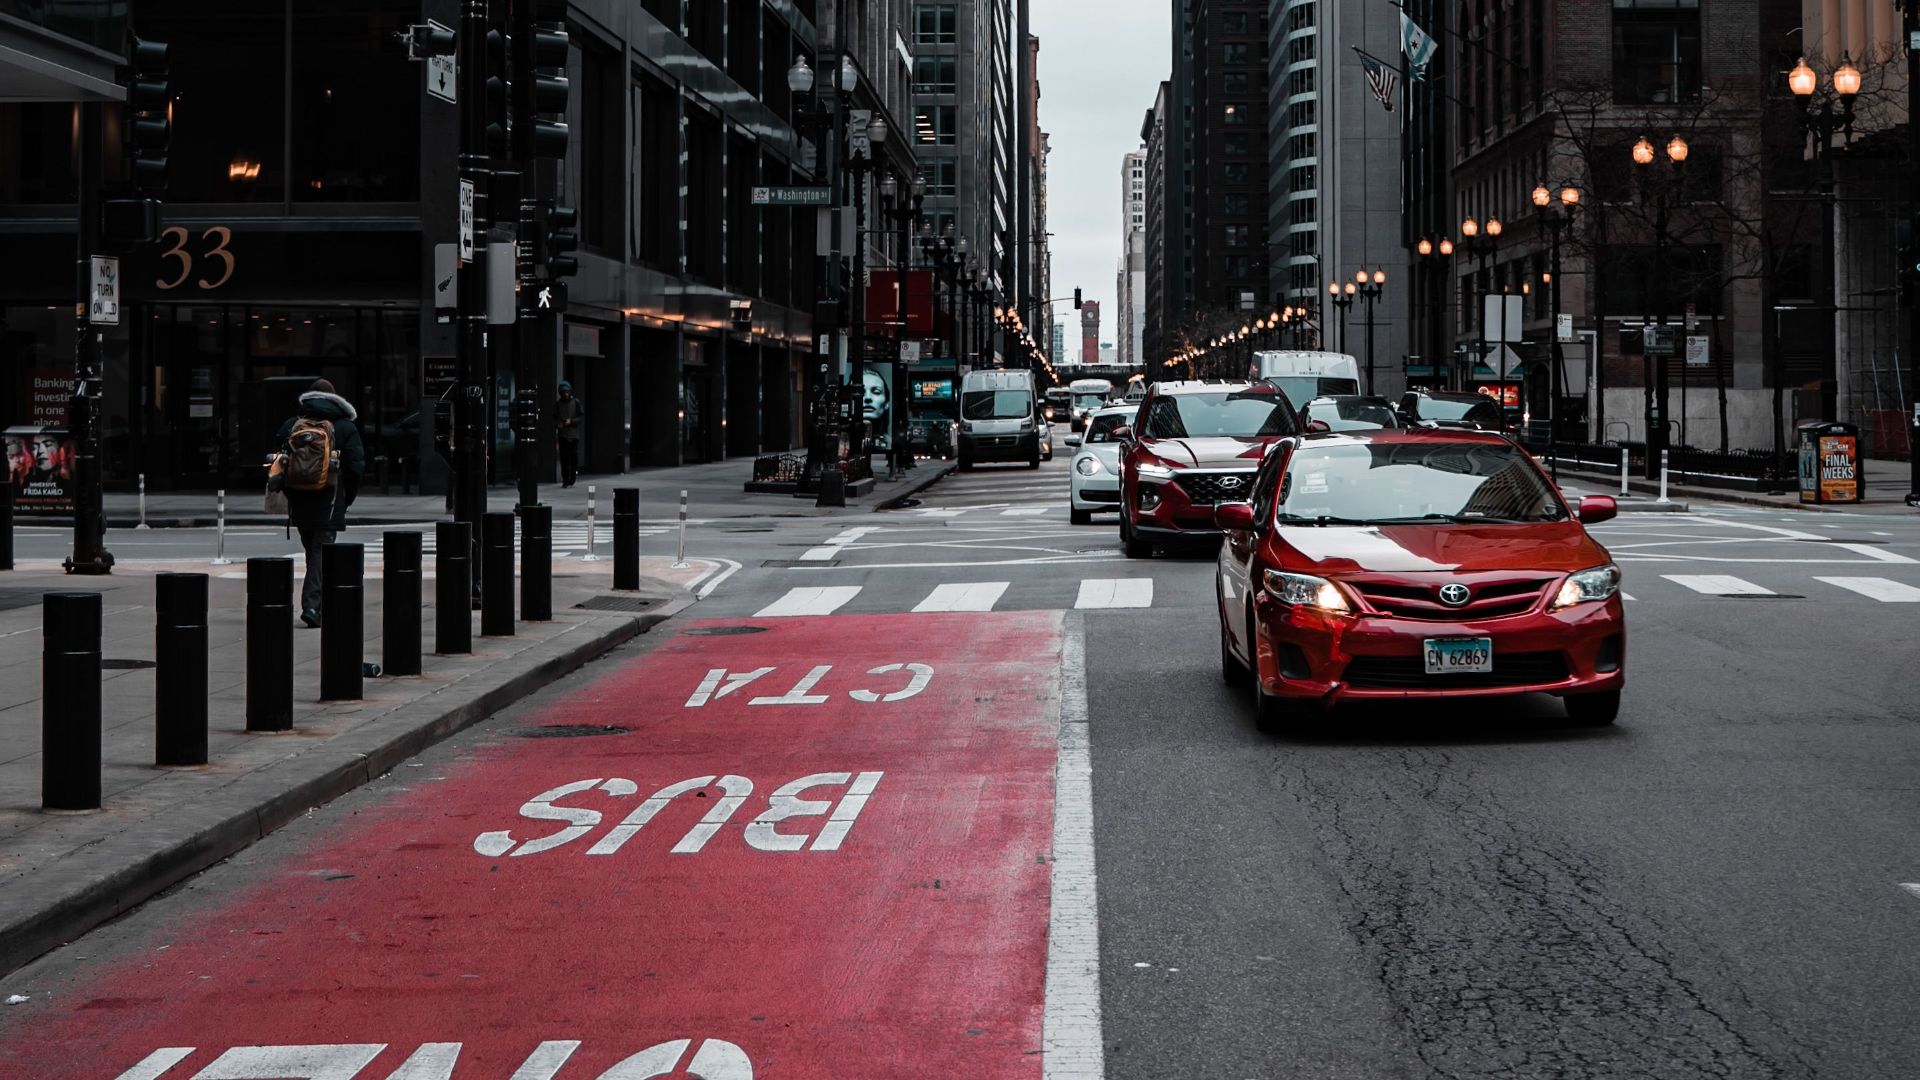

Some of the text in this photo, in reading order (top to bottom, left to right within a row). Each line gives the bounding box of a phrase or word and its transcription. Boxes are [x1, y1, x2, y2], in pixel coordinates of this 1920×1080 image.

[462, 186, 472, 207] ONE
[776, 189, 820, 204] Washington
[462, 209, 472, 228] WAY
[156, 226, 235, 289] 33
[100, 265, 111, 278] NO
[97, 283, 114, 297] TURN
[93, 302, 103, 315] ON
[34, 377, 75, 391] Banking
[34, 406, 44, 415] in
[1825, 454, 1851, 467] FINAL
[1823, 467, 1854, 479] WEEKS
[23, 488, 64, 496] FRIDA KAHLO
[1428, 648, 1488, 666] CN 62869
[684, 663, 935, 707] CTA
[474, 771, 884, 857] BUS
